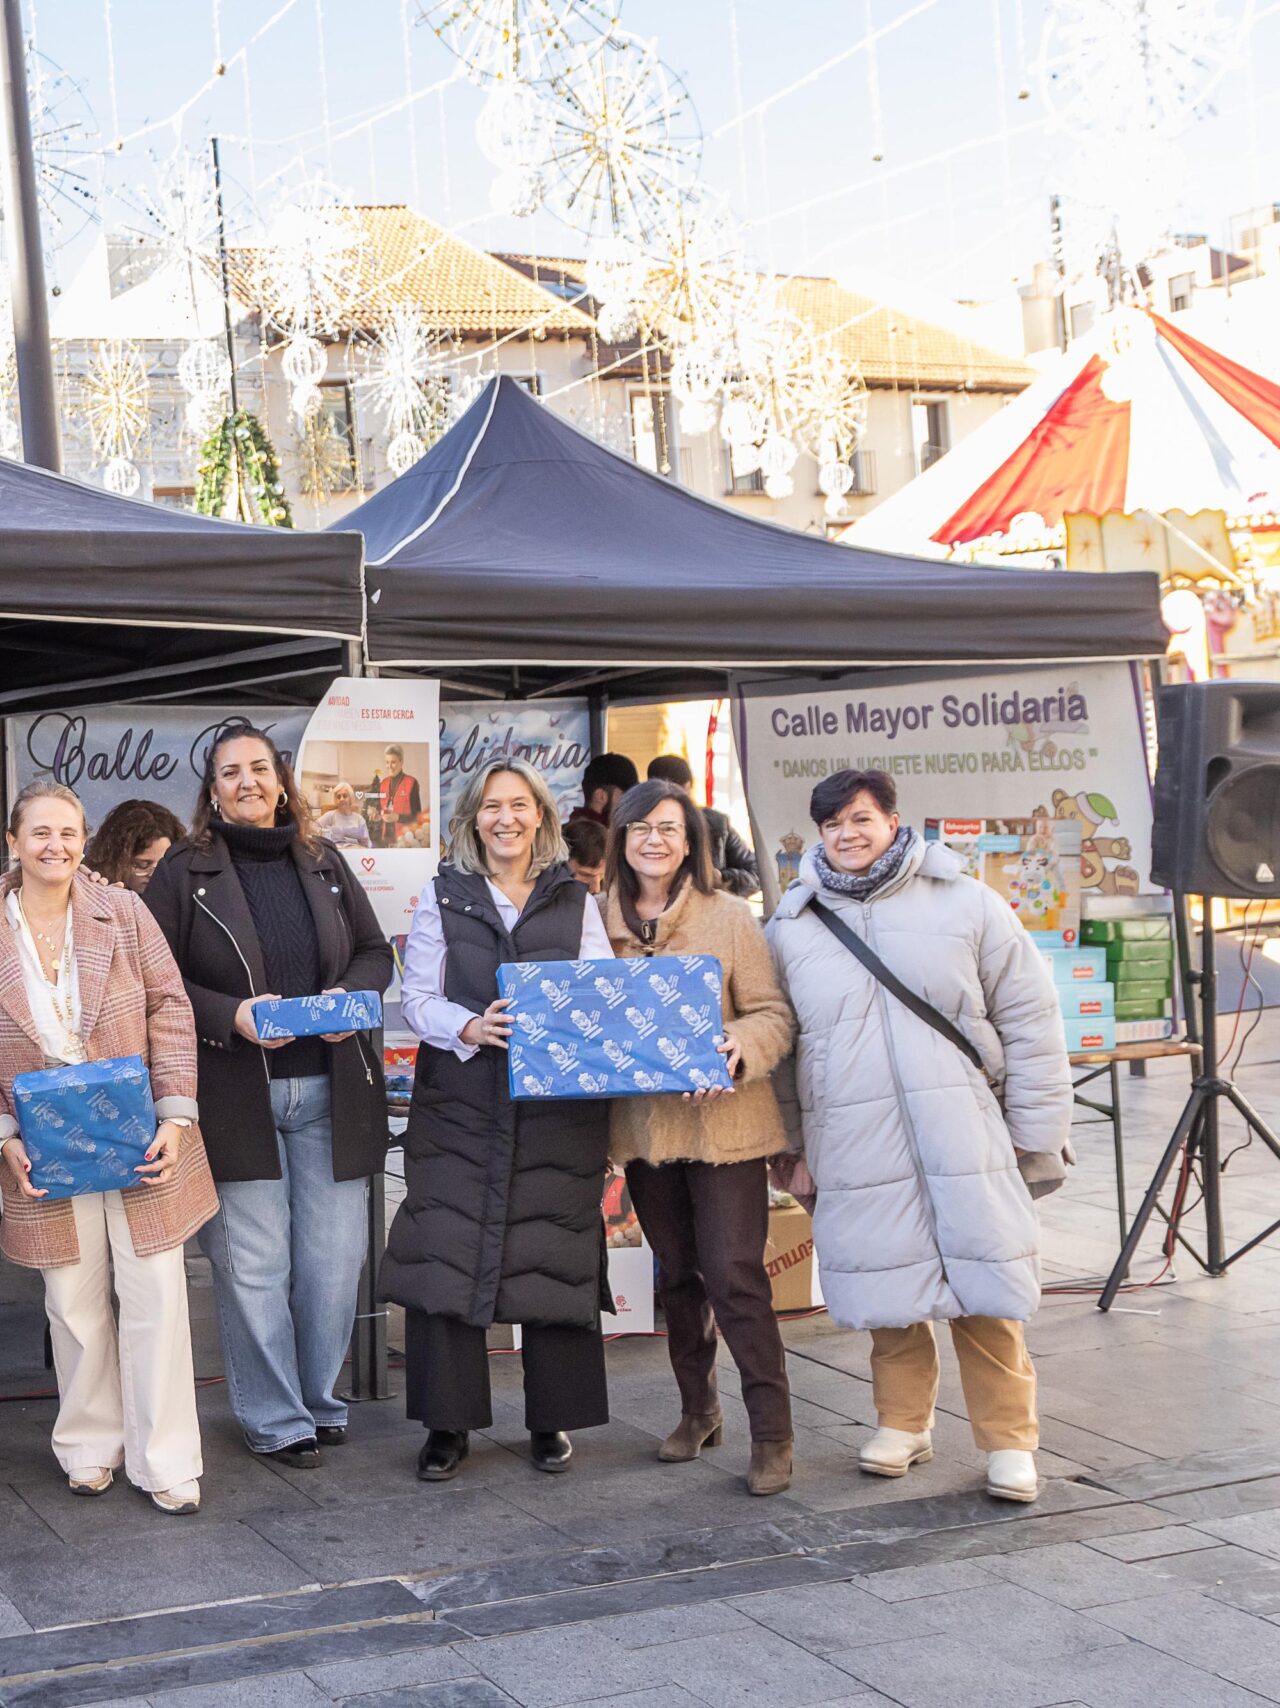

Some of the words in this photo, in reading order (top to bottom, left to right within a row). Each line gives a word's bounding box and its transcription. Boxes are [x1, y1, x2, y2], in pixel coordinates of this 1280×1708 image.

[361, 709, 370, 719] ES
[371, 709, 392, 719] ESTAR
[393, 710, 414, 720] CERCA
[771, 705, 839, 737] Calle
[845, 702, 935, 740] Mayor
[942, 687, 1089, 728] Solidaria
[27, 712, 179, 799] Calle
[439, 718, 590, 774] olidaria
[782, 759, 827, 778] DANOS
[925, 752, 978, 774] NUEVO
[982, 751, 1025, 773] PARA
[1028, 749, 1086, 772] ELLOS
